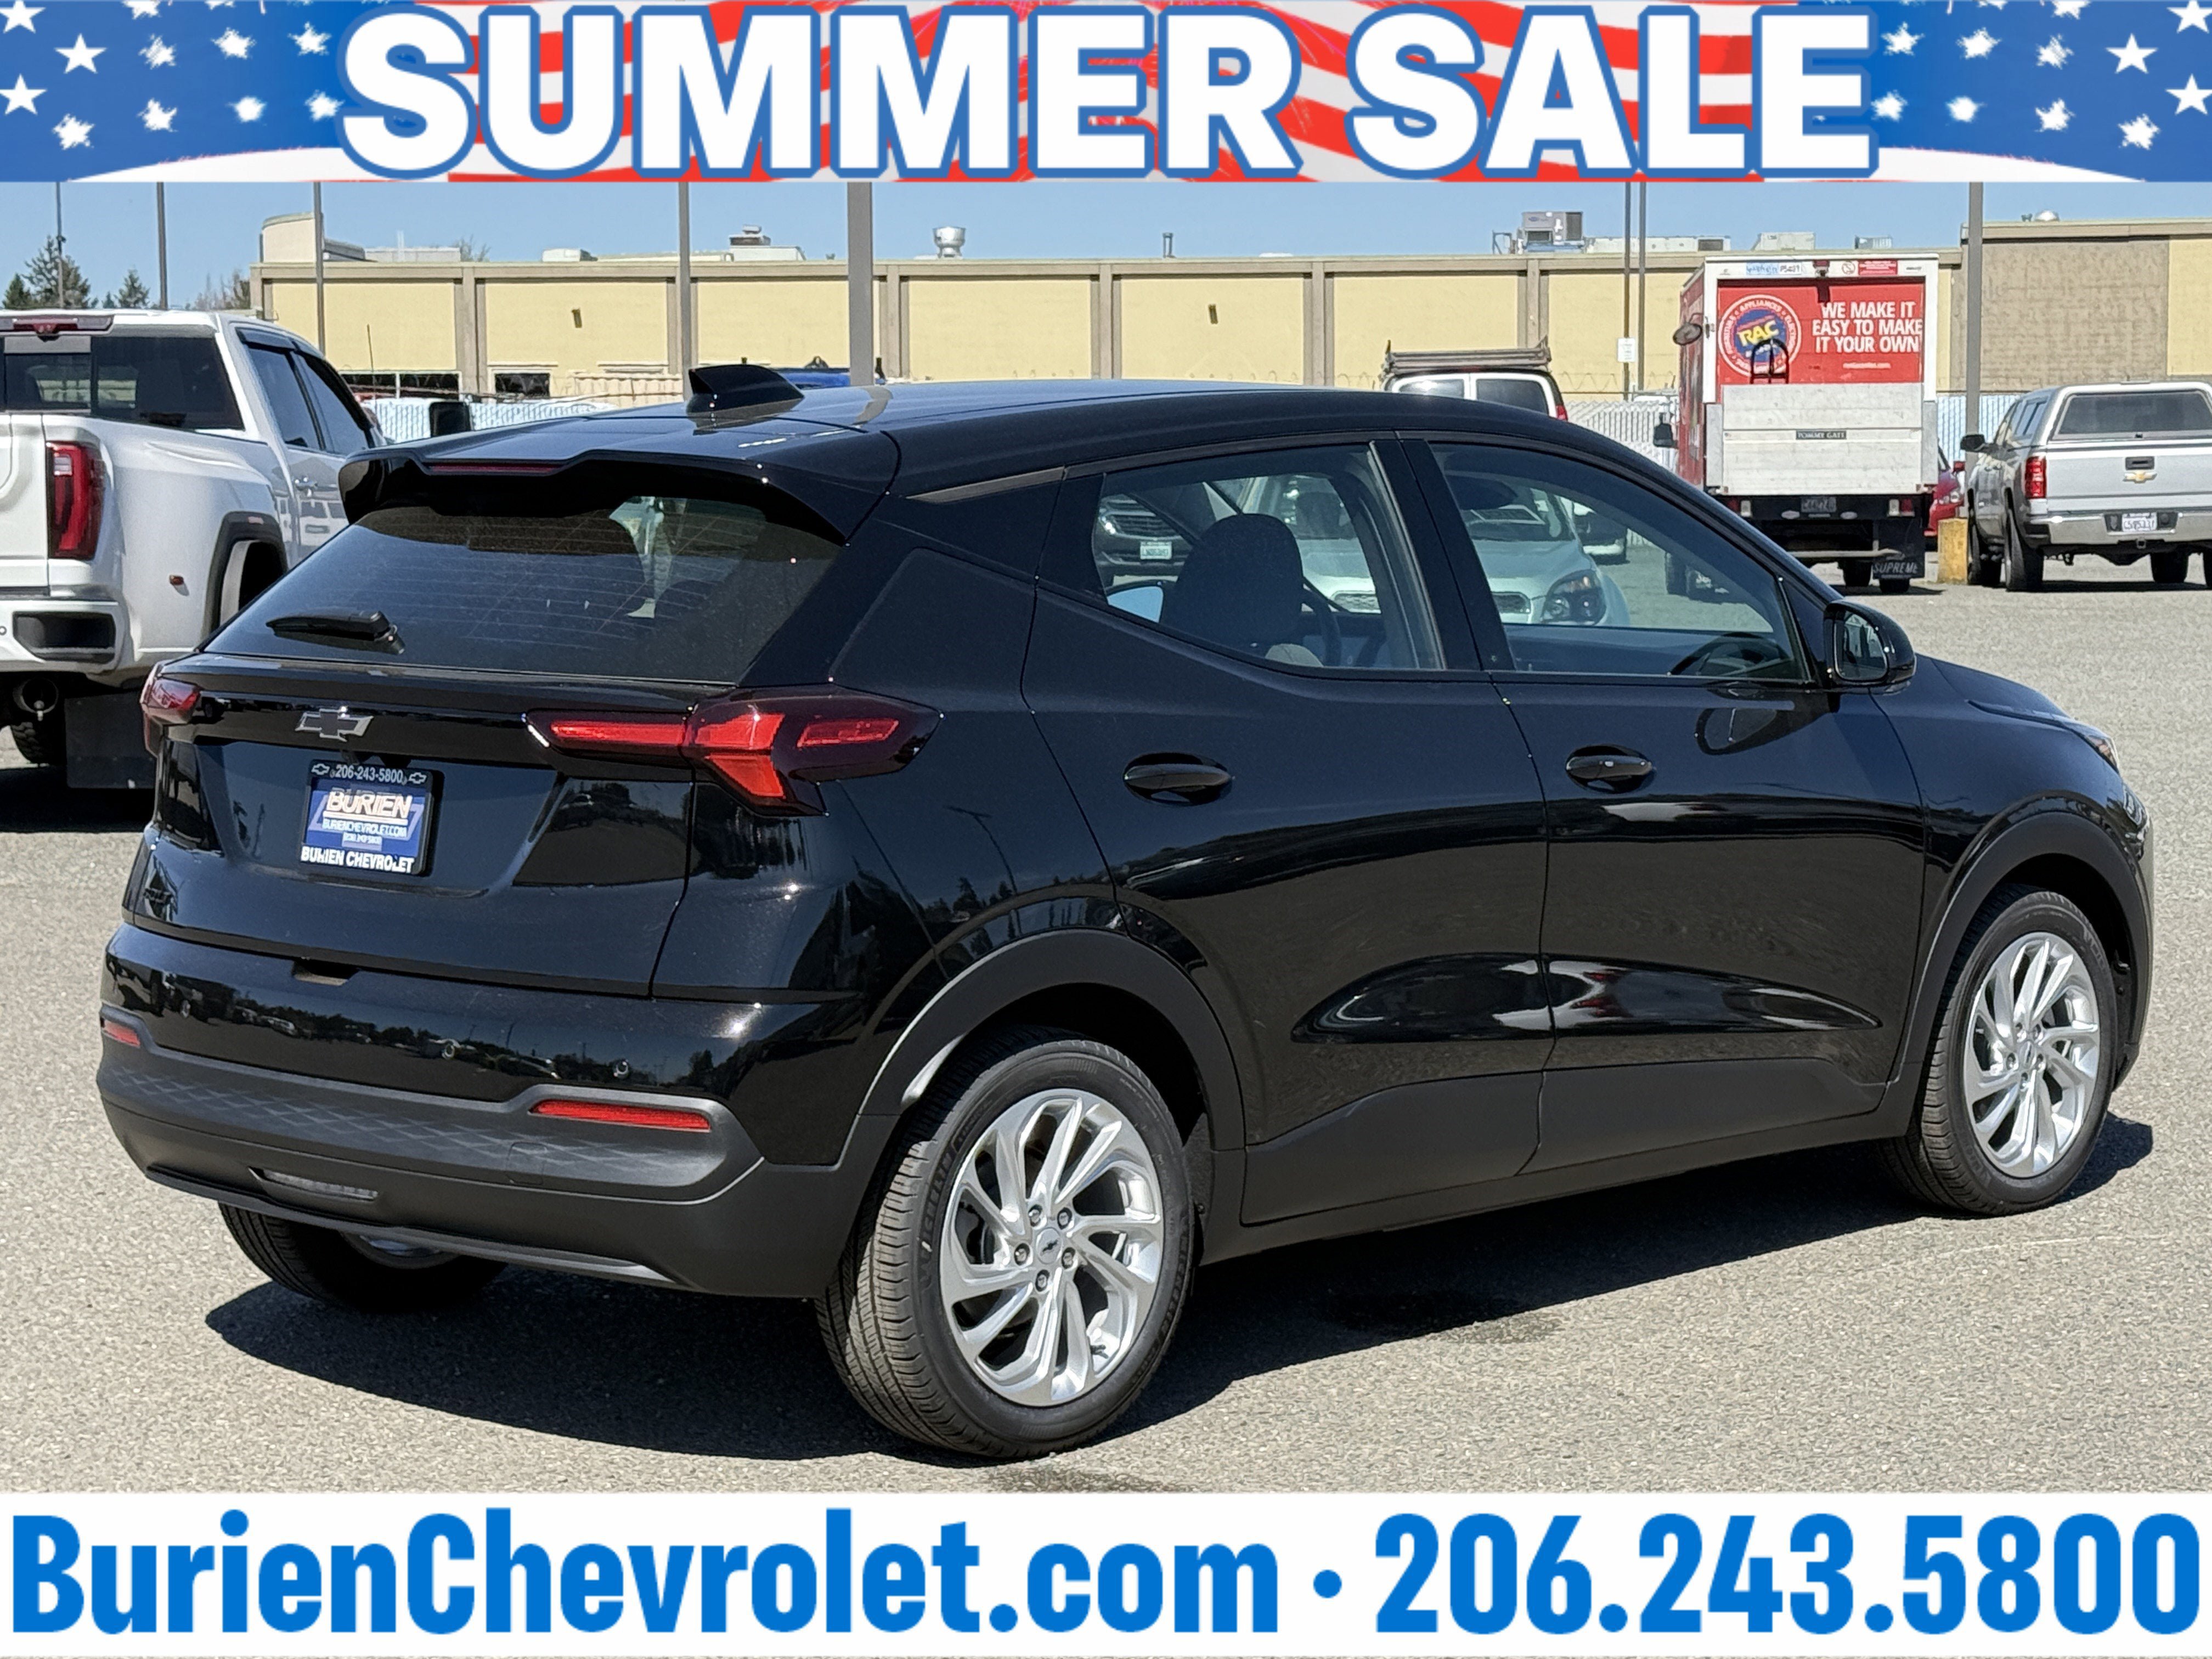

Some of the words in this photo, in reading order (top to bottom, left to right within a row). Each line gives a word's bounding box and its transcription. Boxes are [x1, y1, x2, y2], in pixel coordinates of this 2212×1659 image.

[1821, 301, 1846, 318] WE
[1850, 301, 1895, 318] MAKE
[1900, 301, 1916, 318] IT
[1737, 320, 1779, 347] RAC
[1813, 319, 1850, 336] EASY
[1854, 319, 1874, 336] TO
[1879, 319, 1923, 336] MAKE
[1815, 336, 1831, 353] IT
[1835, 336, 1876, 353] YOUR
[1880, 336, 1920, 353] OWN
[335, 764, 404, 783] 206-243-5800
[326, 790, 412, 819] BURIEN
[301, 846, 345, 866] BURIEN
